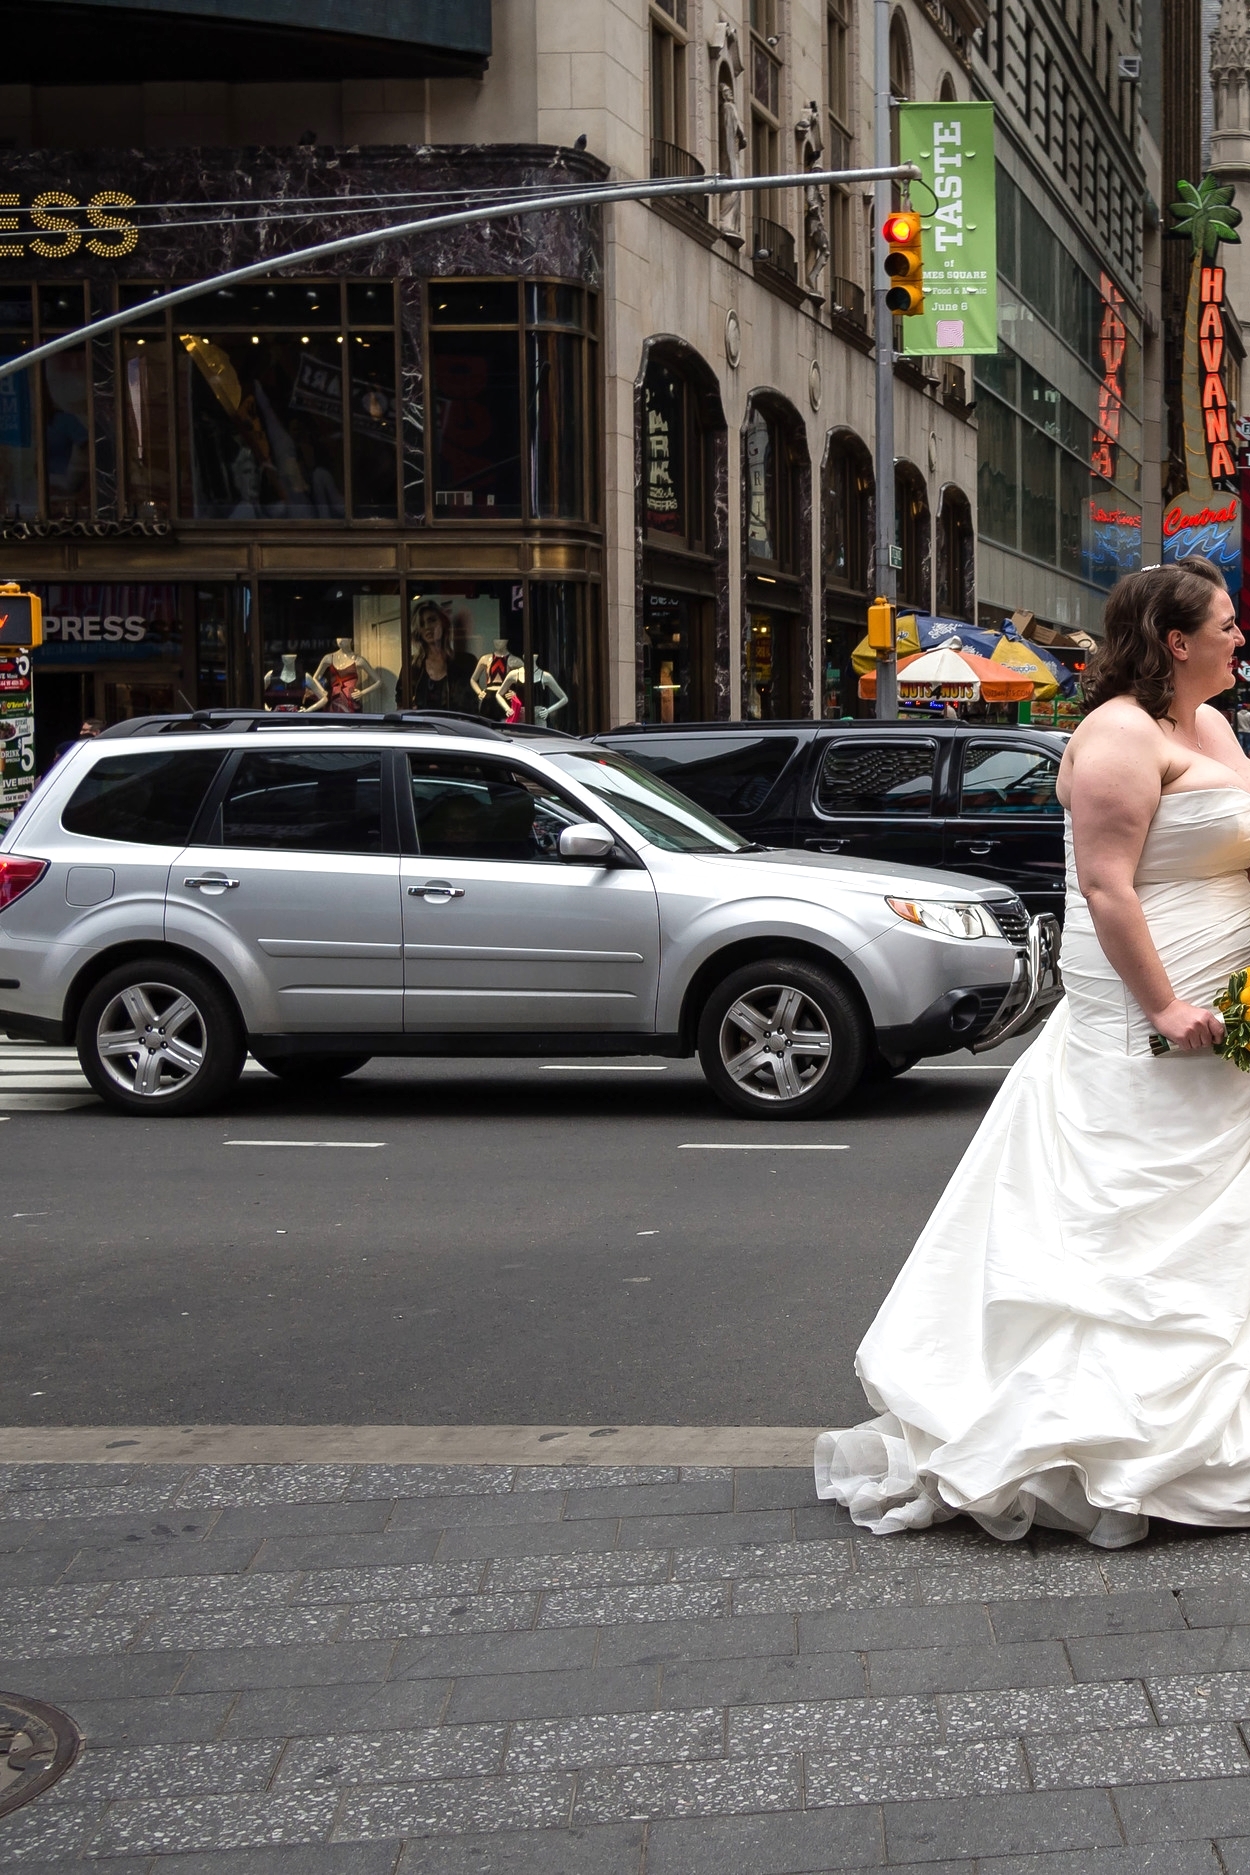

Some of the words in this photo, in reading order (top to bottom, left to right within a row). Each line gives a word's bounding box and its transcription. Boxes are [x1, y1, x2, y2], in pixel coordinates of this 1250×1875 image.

[933, 121, 963, 252] TASTE
[0, 191, 138, 257] ESS
[944, 259, 955, 268] of
[947, 271, 987, 280] SQUARE
[932, 287, 952, 295] Food
[954, 287, 960, 295] &
[962, 286, 988, 295] Mic
[931, 302, 958, 311] June
[1200, 267, 1236, 478] HAVANA
[1163, 500, 1237, 536] Central
[43, 615, 147, 642] PRESS
[900, 682, 933, 699] NUTS
[932, 684, 942, 700] 4
[941, 682, 974, 699] NUTS
